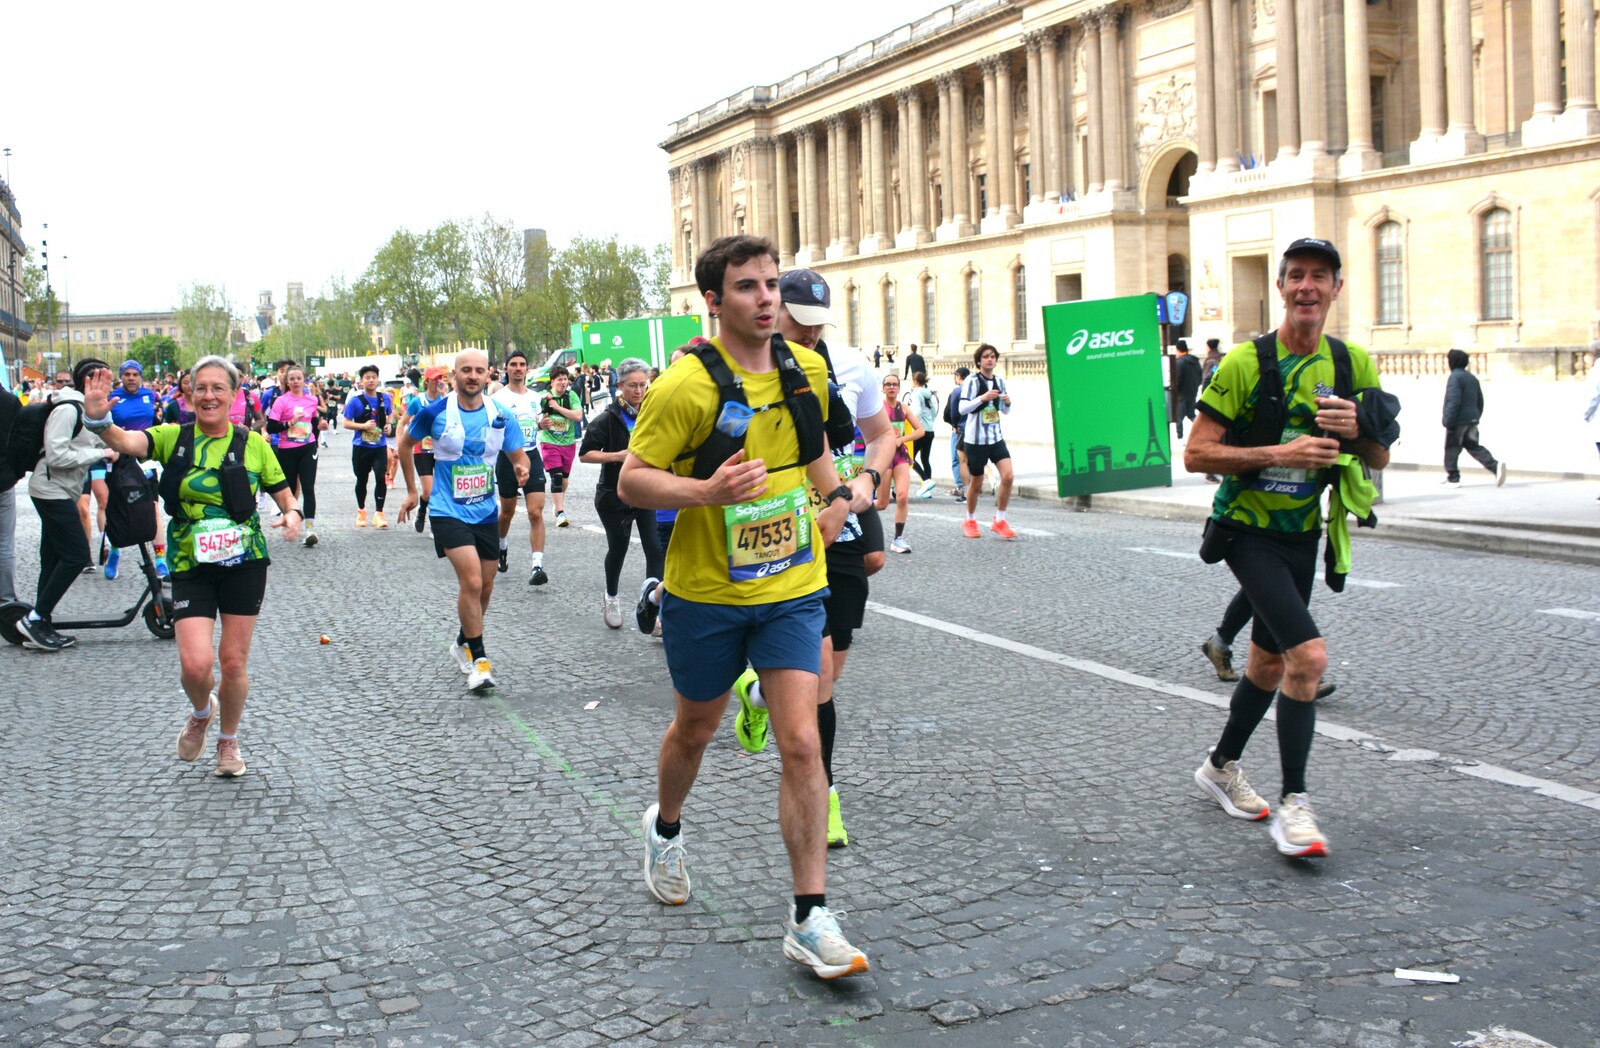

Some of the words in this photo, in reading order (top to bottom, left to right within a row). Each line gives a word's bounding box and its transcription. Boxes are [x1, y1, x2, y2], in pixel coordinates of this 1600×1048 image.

[1088, 329, 1134, 349] asics
[456, 475, 486, 490] 66106
[1275, 484, 1298, 493] asics
[735, 498, 787, 516] Schneider
[199, 531, 239, 553] 54754
[737, 517, 792, 550] 47533
[769, 559, 791, 573] asics
